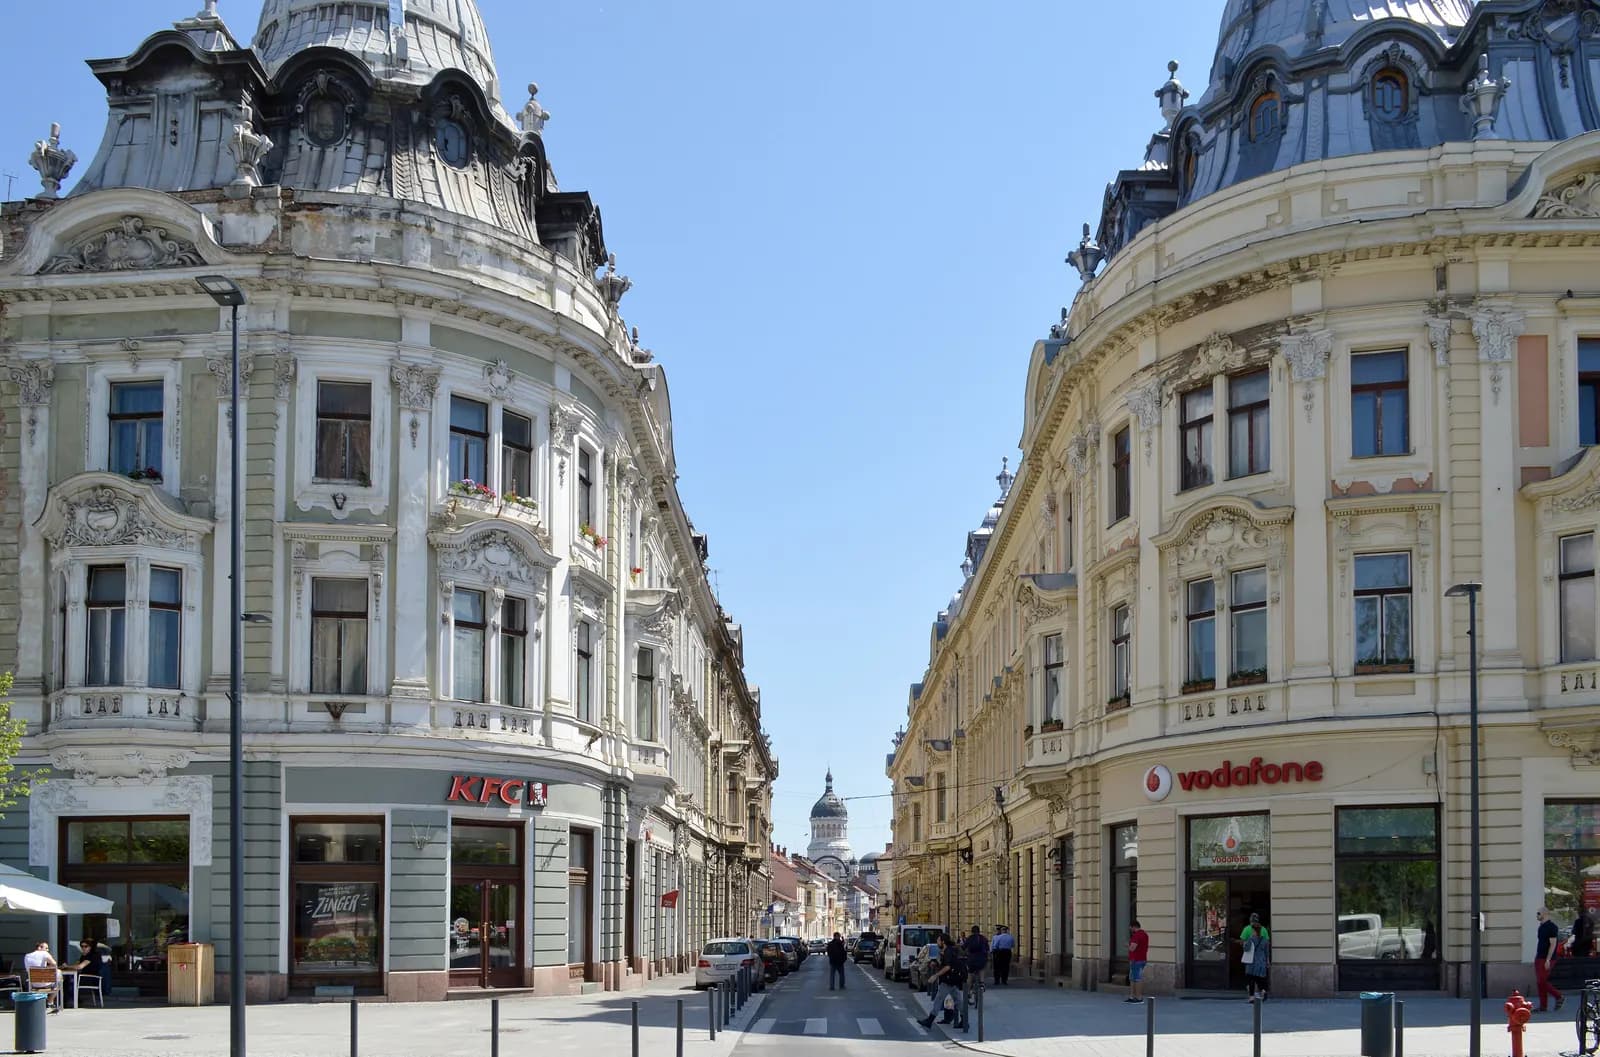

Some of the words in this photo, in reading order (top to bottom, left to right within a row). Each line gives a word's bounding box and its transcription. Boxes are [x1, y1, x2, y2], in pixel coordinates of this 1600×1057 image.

[1177, 756, 1324, 791] vodafone
[447, 776, 524, 805] KFC
[1212, 854, 1250, 864] vodafone
